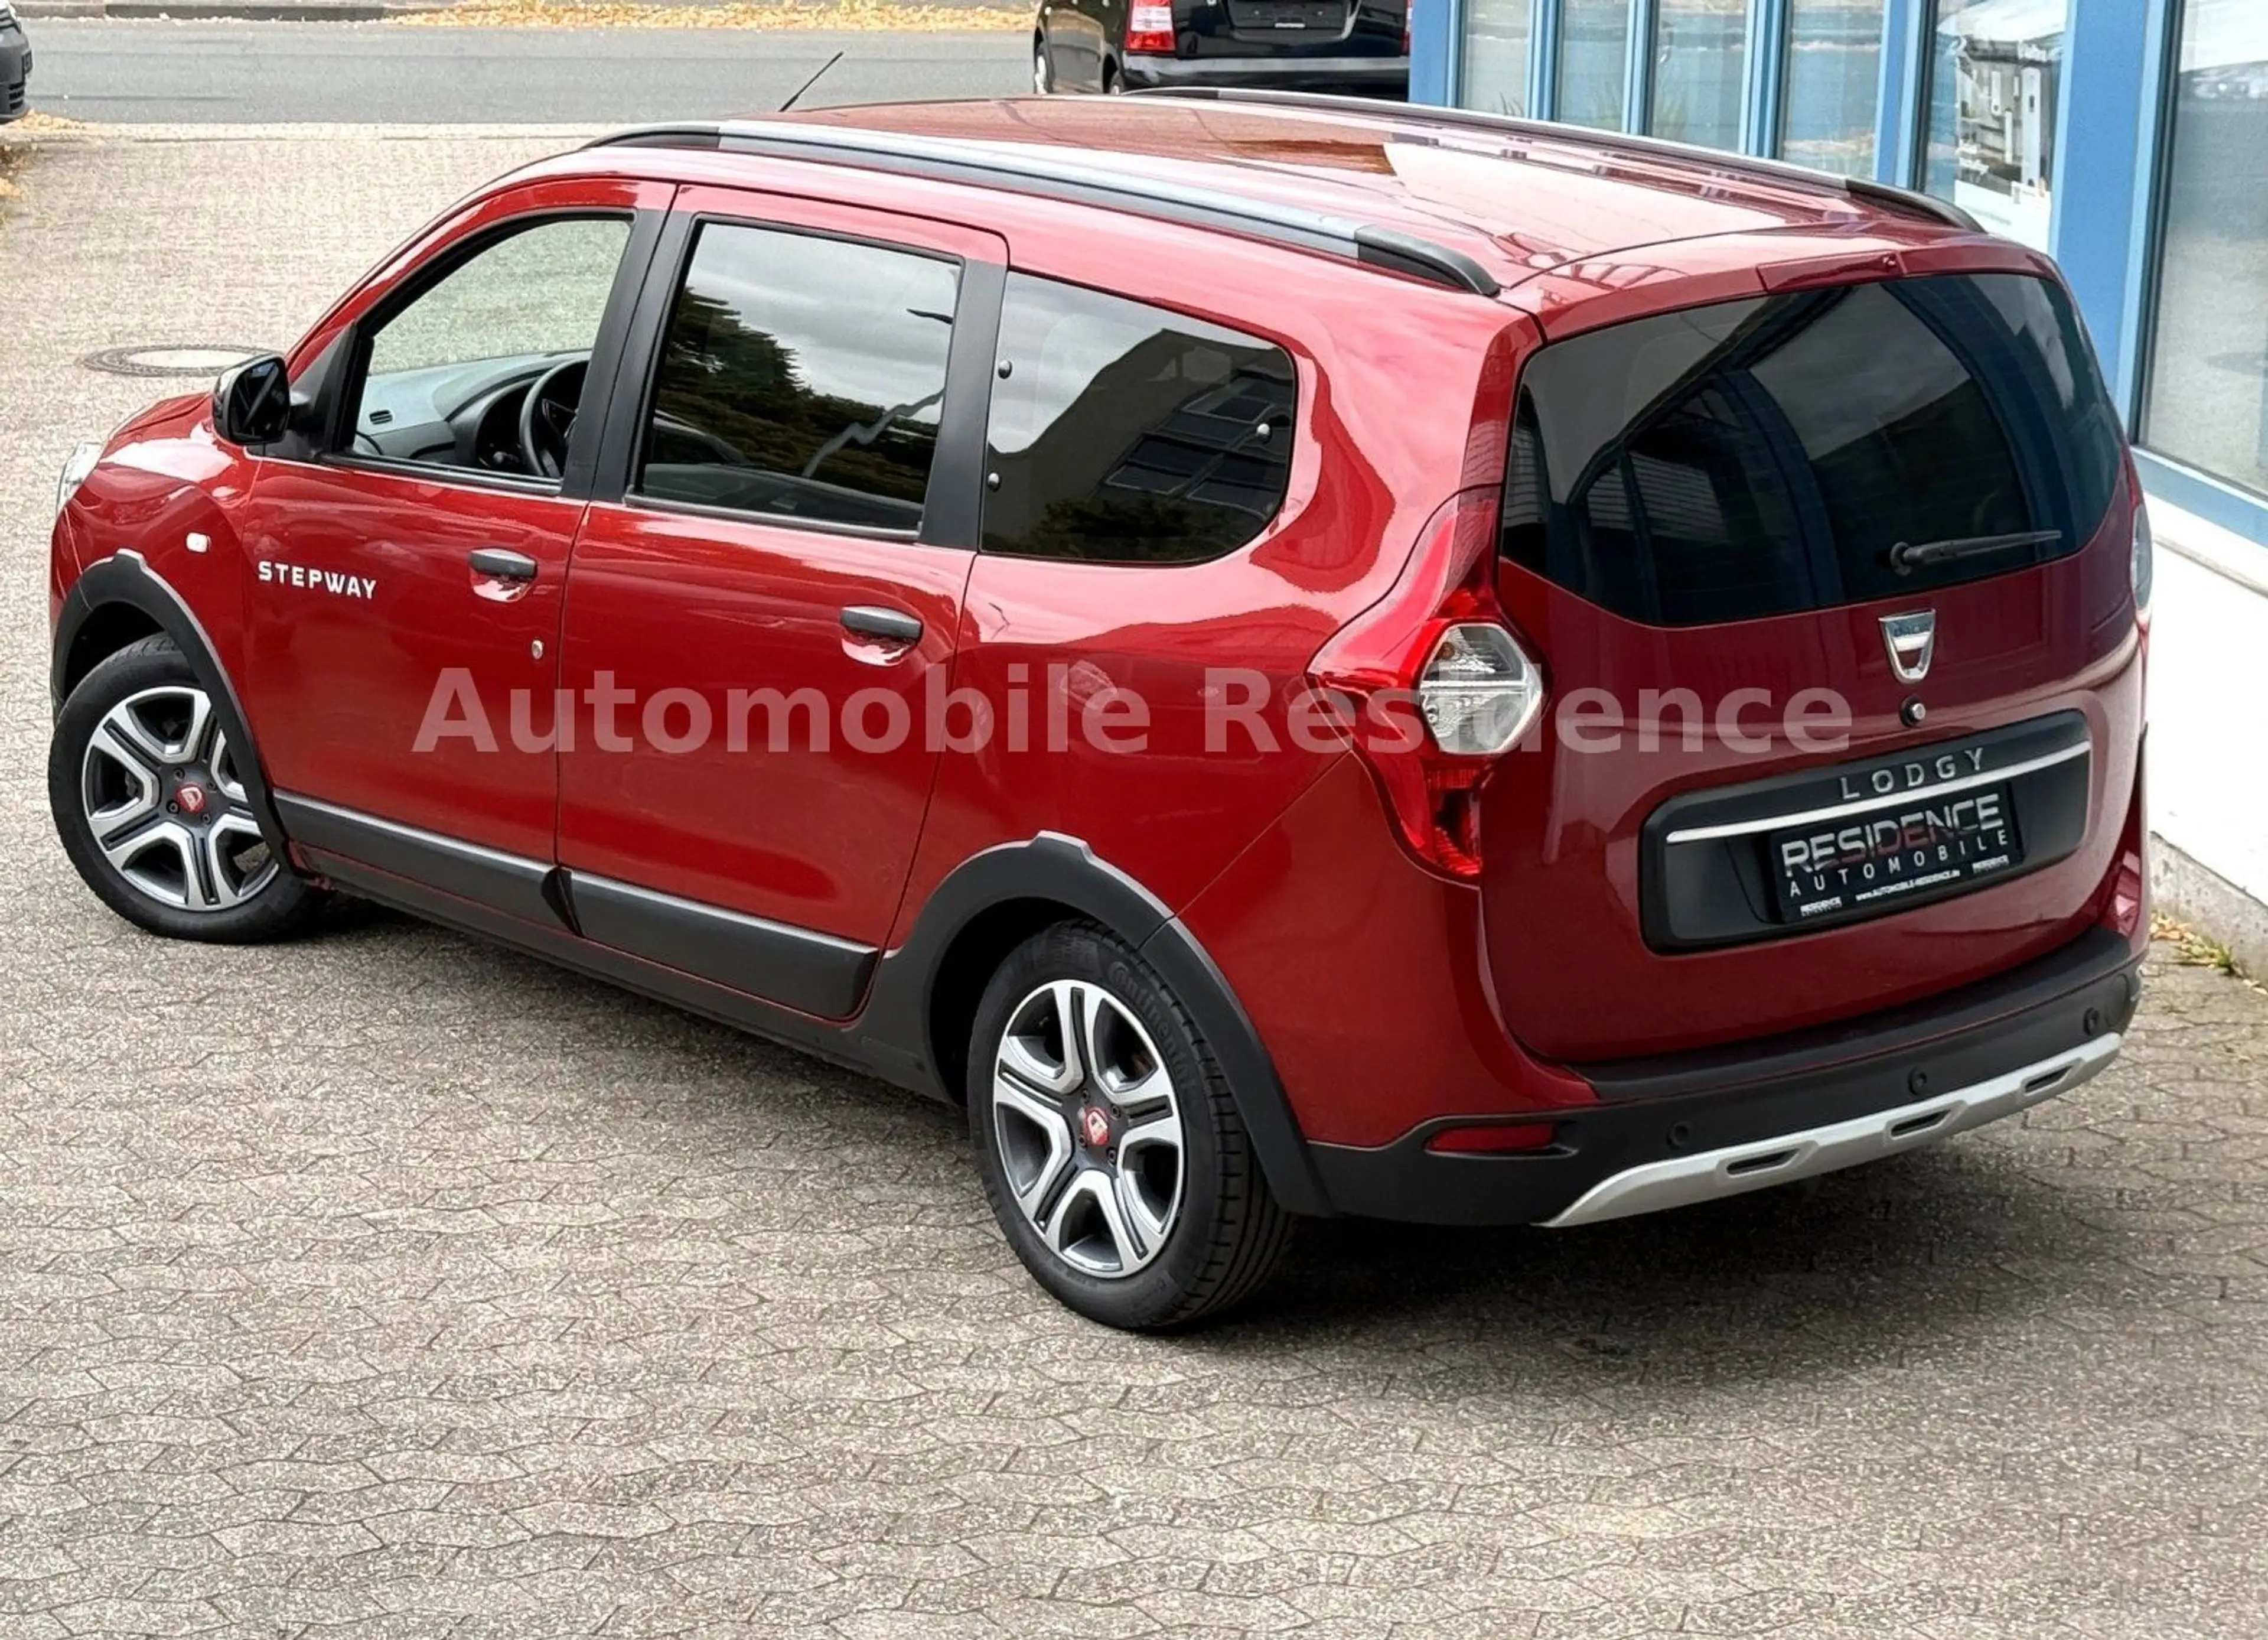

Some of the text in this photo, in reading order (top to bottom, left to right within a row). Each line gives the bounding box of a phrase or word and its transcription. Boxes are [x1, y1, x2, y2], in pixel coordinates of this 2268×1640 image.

[258, 561, 376, 599] STEPWAY
[1839, 747, 1983, 800] LODGY
[1781, 793, 2004, 877] RESIDENCE
[1790, 829, 2008, 898] AUTOMOBILE
